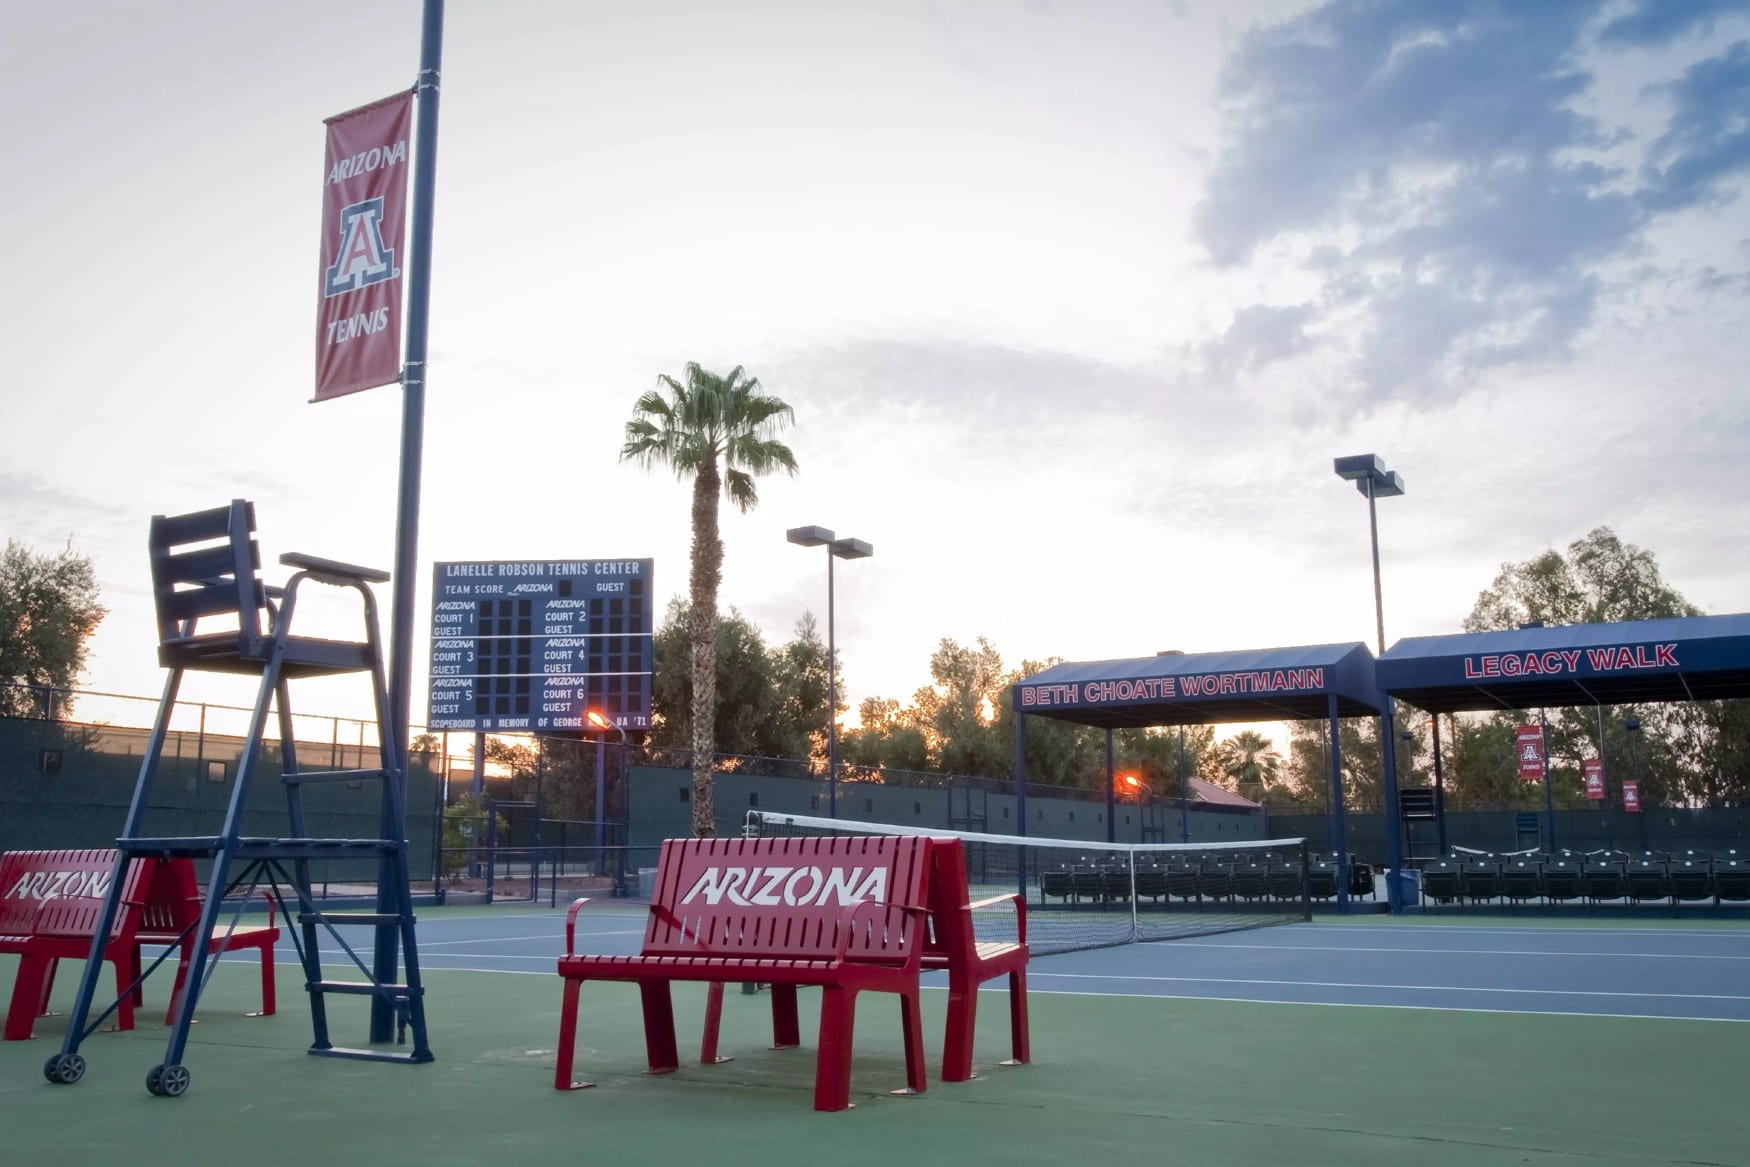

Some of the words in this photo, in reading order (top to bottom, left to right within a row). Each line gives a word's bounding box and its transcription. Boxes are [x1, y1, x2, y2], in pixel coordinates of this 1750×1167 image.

[326, 140, 406, 185] ARIZONA
[327, 306, 389, 345] TENNIS
[447, 565, 494, 576] LANELLE
[499, 563, 544, 576] ROBSON
[548, 563, 588, 575] TENNIS
[594, 562, 640, 574] CENTER
[445, 585, 471, 594] TEAM
[474, 585, 504, 594] SCORE
[513, 583, 553, 592] ARIZONA
[596, 583, 625, 591] GUEST
[435, 602, 475, 610] ARIZONA
[545, 600, 585, 608] ARIZONA
[434, 614, 463, 623] COURT
[469, 613, 474, 623] 1
[545, 612, 574, 621] COURT
[578, 611, 586, 622] 2
[434, 627, 462, 636] GUEST
[545, 625, 573, 634] GUEST
[434, 640, 474, 648] ARIZONA
[545, 638, 585, 647] ARIZONA
[433, 652, 462, 661] COURT
[467, 651, 474, 662] 3
[544, 651, 573, 660] COURT
[578, 650, 585, 660] 4
[1464, 649, 1582, 679] LEGACY
[1586, 643, 1680, 671] WALK
[432, 665, 461, 674] GUEST
[543, 664, 572, 673] GUEST
[432, 678, 472, 687] ARIZONA
[544, 677, 584, 685] ARIZONA
[1021, 684, 1079, 706] BETH
[1084, 677, 1176, 701] CHOATE
[1179, 667, 1325, 696] WORTMANN
[431, 691, 461, 700] COURT
[465, 690, 473, 701] 5
[543, 690, 572, 699] COURT
[577, 688, 584, 699] 6
[431, 704, 460, 713] GUEST
[543, 703, 571, 712] GUEST
[430, 719, 476, 728] SCOREBOARD
[482, 719, 491, 728] IN
[498, 718, 530, 728] MEMORY
[538, 718, 548, 727] OF
[553, 717, 582, 727] GEORGE
[616, 716, 628, 726] UA
[633, 716, 647, 726] '71
[4, 870, 112, 900] ARIZON
[680, 866, 888, 906] ARIZONA
